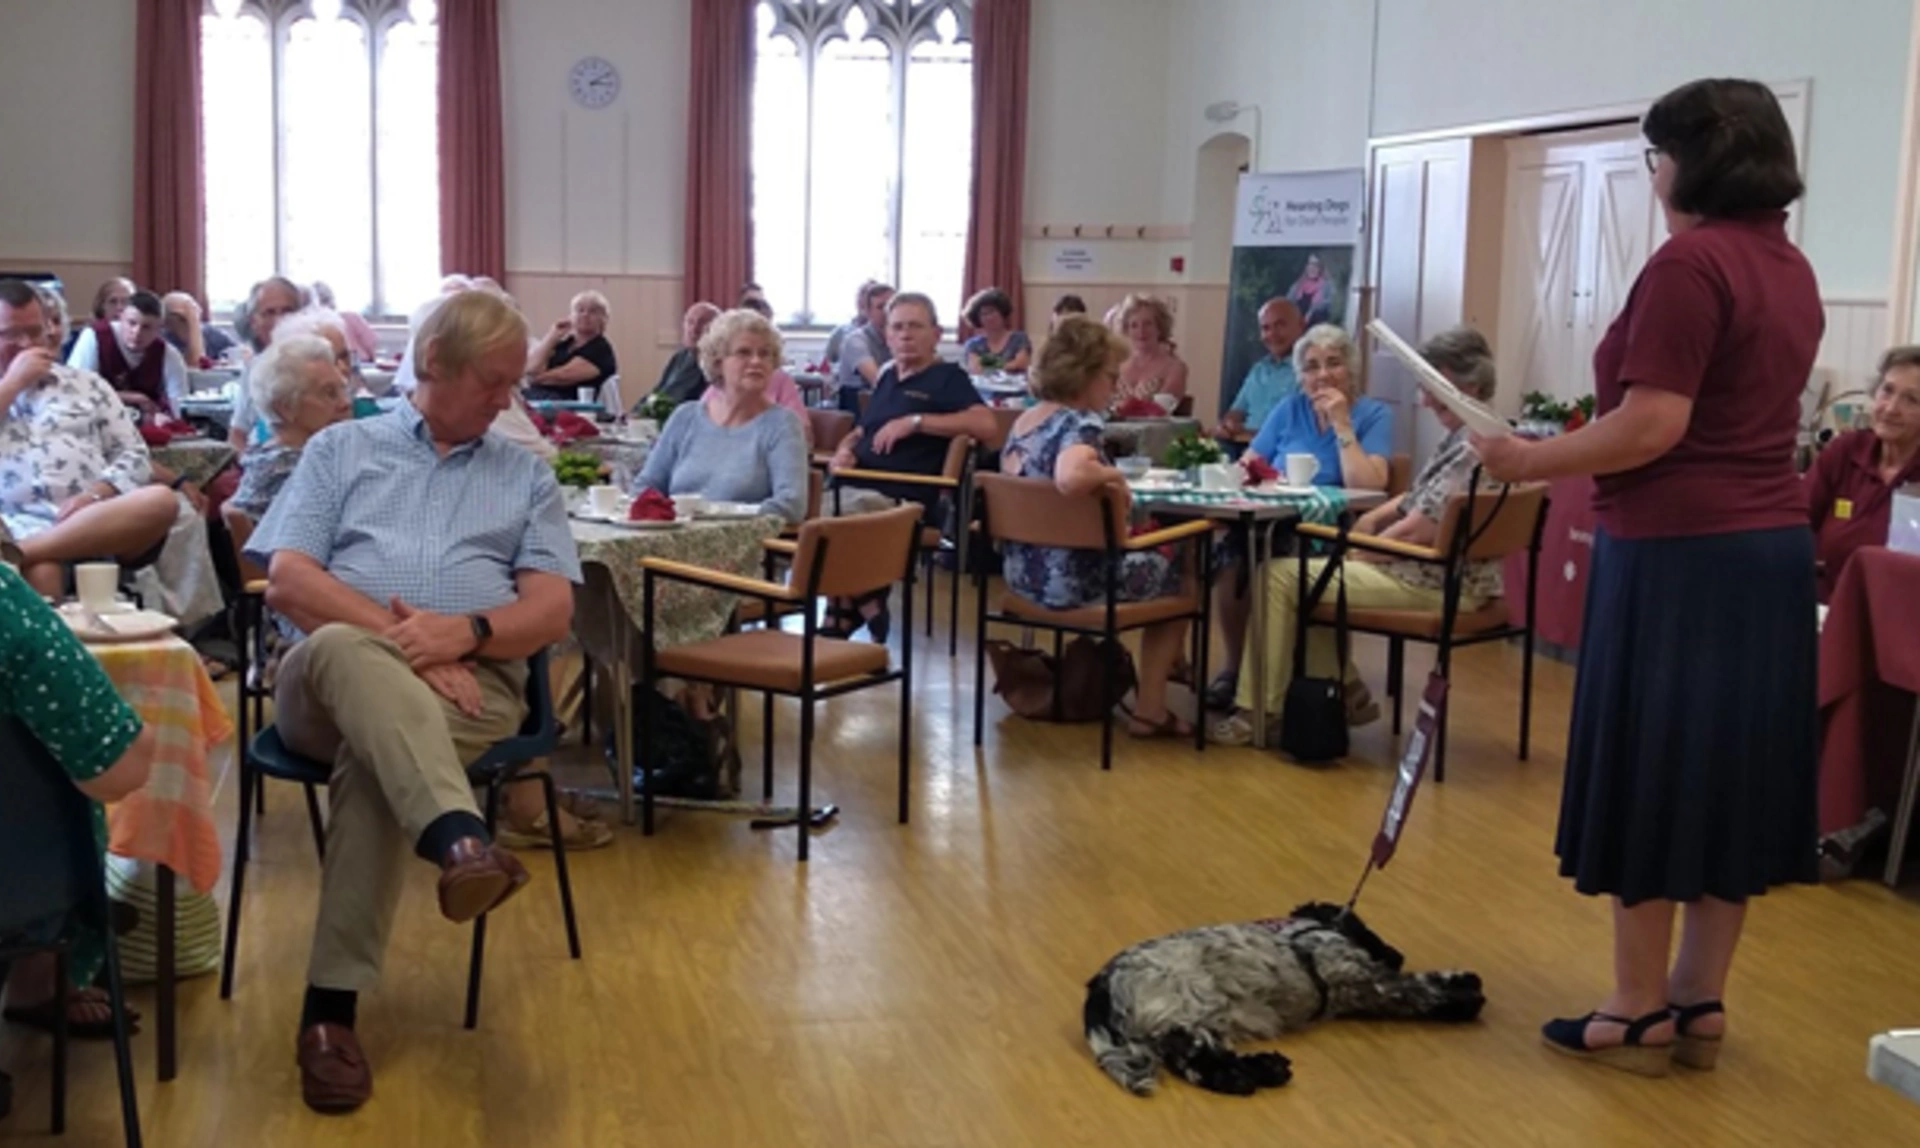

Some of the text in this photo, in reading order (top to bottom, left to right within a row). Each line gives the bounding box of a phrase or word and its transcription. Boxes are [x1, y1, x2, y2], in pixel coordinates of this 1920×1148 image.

[1286, 198, 1350, 214] Hearing Dogs
[1299, 215, 1317, 227] Deaf
[1321, 215, 1349, 227] People
